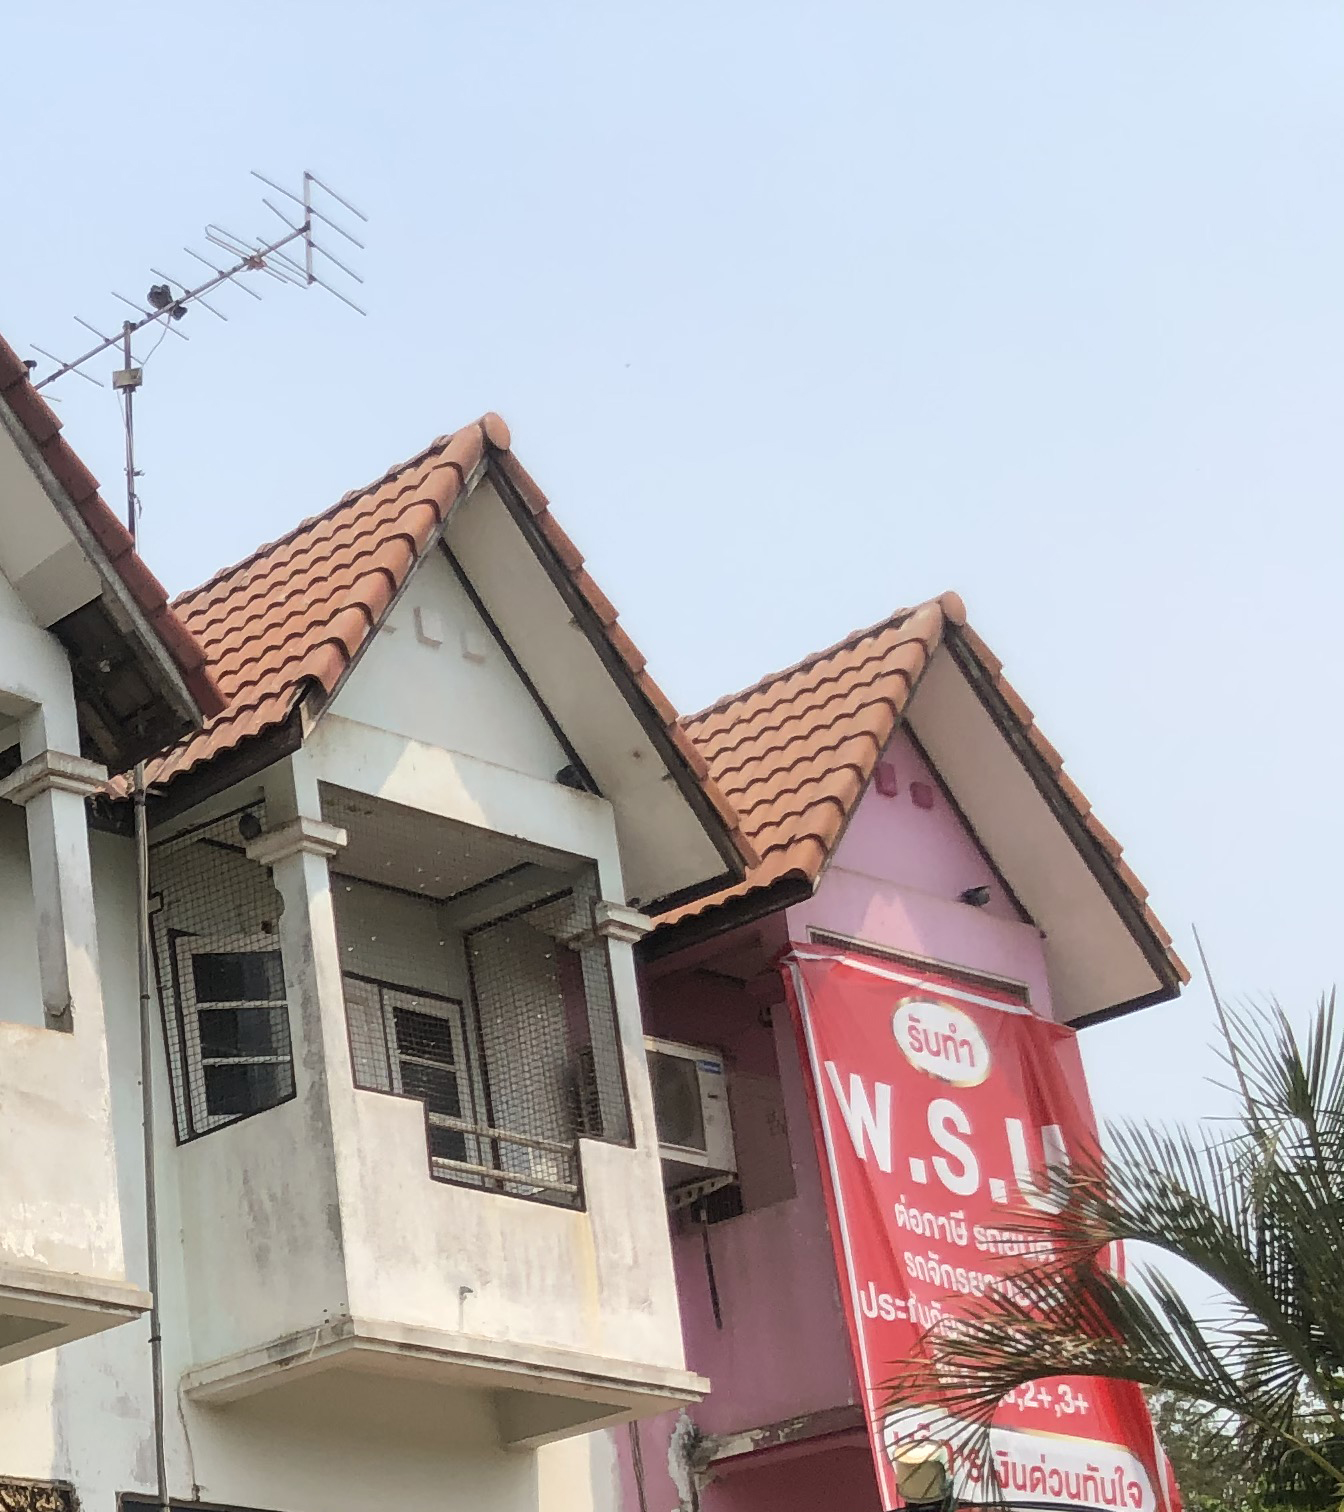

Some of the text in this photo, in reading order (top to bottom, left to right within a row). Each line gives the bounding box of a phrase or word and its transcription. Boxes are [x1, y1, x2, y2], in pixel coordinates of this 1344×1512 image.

[907, 1014, 976, 1068] รับทำ
[894, 1194, 969, 1246] ต่อภาษี
